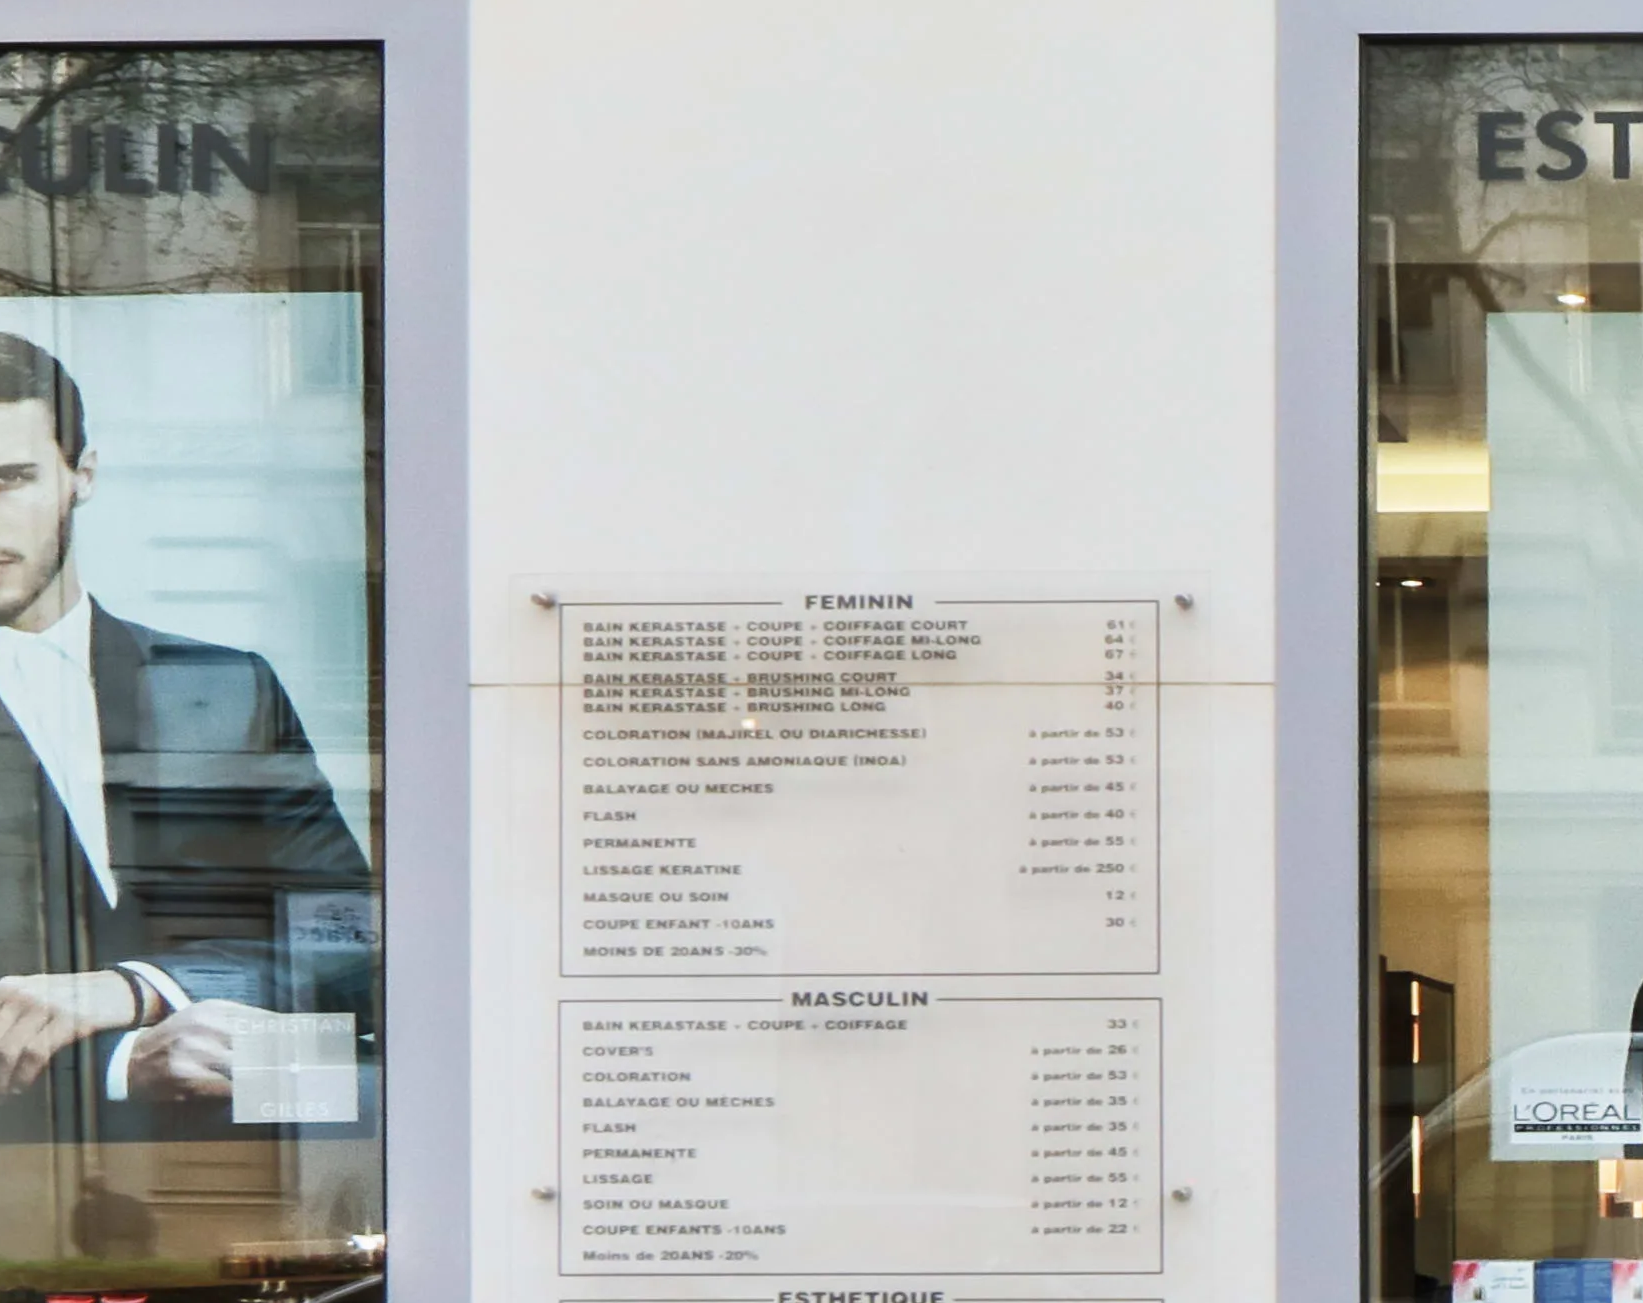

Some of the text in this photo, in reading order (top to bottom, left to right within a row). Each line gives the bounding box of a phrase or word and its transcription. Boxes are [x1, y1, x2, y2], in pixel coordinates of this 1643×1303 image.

[805, 594, 914, 610] FEMININ
[583, 621, 968, 632] BAIN KERASTASE COUPE COIFFAGE COURT
[583, 638, 623, 646] BAIN
[629, 637, 726, 646] KERASTASE
[746, 637, 803, 646] COUPE
[823, 636, 904, 645] COIFFAGE
[583, 650, 958, 661] BAIN KERASTASE COUPE COIFFAGE LONG
[582, 673, 895, 685] BAIN KERASTASE BRUSHING COURT
[583, 689, 623, 697] BAIN
[630, 688, 726, 697] KERASTASE
[747, 688, 834, 696] BRUSHING
[582, 703, 887, 713] BAIN KERASTASE BRUSHING LONG
[582, 730, 691, 740] COLORATION
[582, 757, 691, 767] COLORATION
[695, 757, 741, 766] SANS
[582, 785, 671, 794] BALAYAGE
[582, 812, 637, 821] FLASH
[582, 838, 697, 848] PERMANENTE
[582, 865, 743, 875] LISSAGE KERATINE
[583, 892, 729, 902] MASQUE SOIN
[582, 919, 712, 929] COUPE ENFANT
[791, 991, 930, 1007] MASCULIN
[582, 1020, 908, 1031] BAIN KERASTASE COUPE COIFFAGE
[582, 1072, 691, 1082] COLORATION
[582, 1098, 672, 1107] BALAYAGE
[260, 1102, 330, 1119] GILLES
[582, 1123, 637, 1133] FLASH
[582, 1149, 697, 1158] PERMANENTE
[582, 1174, 654, 1184] LISSAGE
[582, 1200, 729, 1209] SOIN MASQUE
[581, 1225, 723, 1235] COUPE ENFANTS
